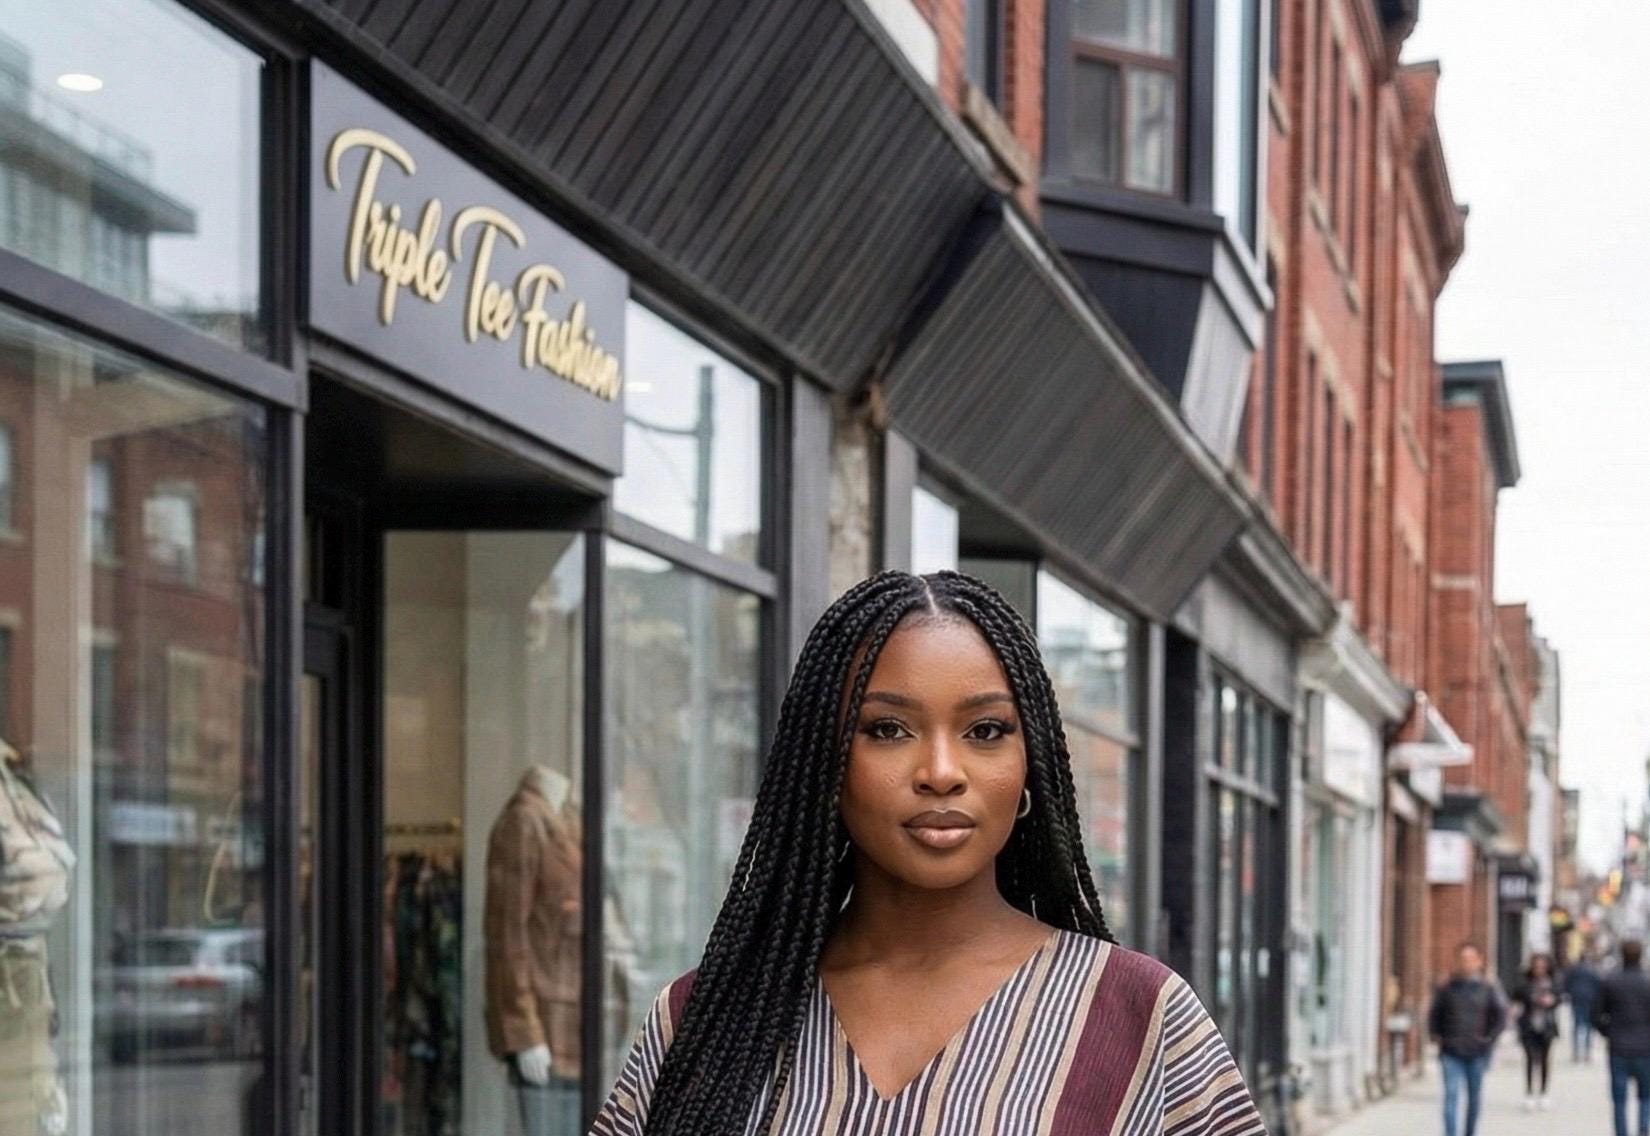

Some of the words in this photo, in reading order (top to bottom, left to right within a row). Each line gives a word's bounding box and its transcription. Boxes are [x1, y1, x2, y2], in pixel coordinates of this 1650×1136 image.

[328, 127, 452, 326] Triple
[451, 205, 527, 343] Tee
[518, 263, 622, 402] Fashion
